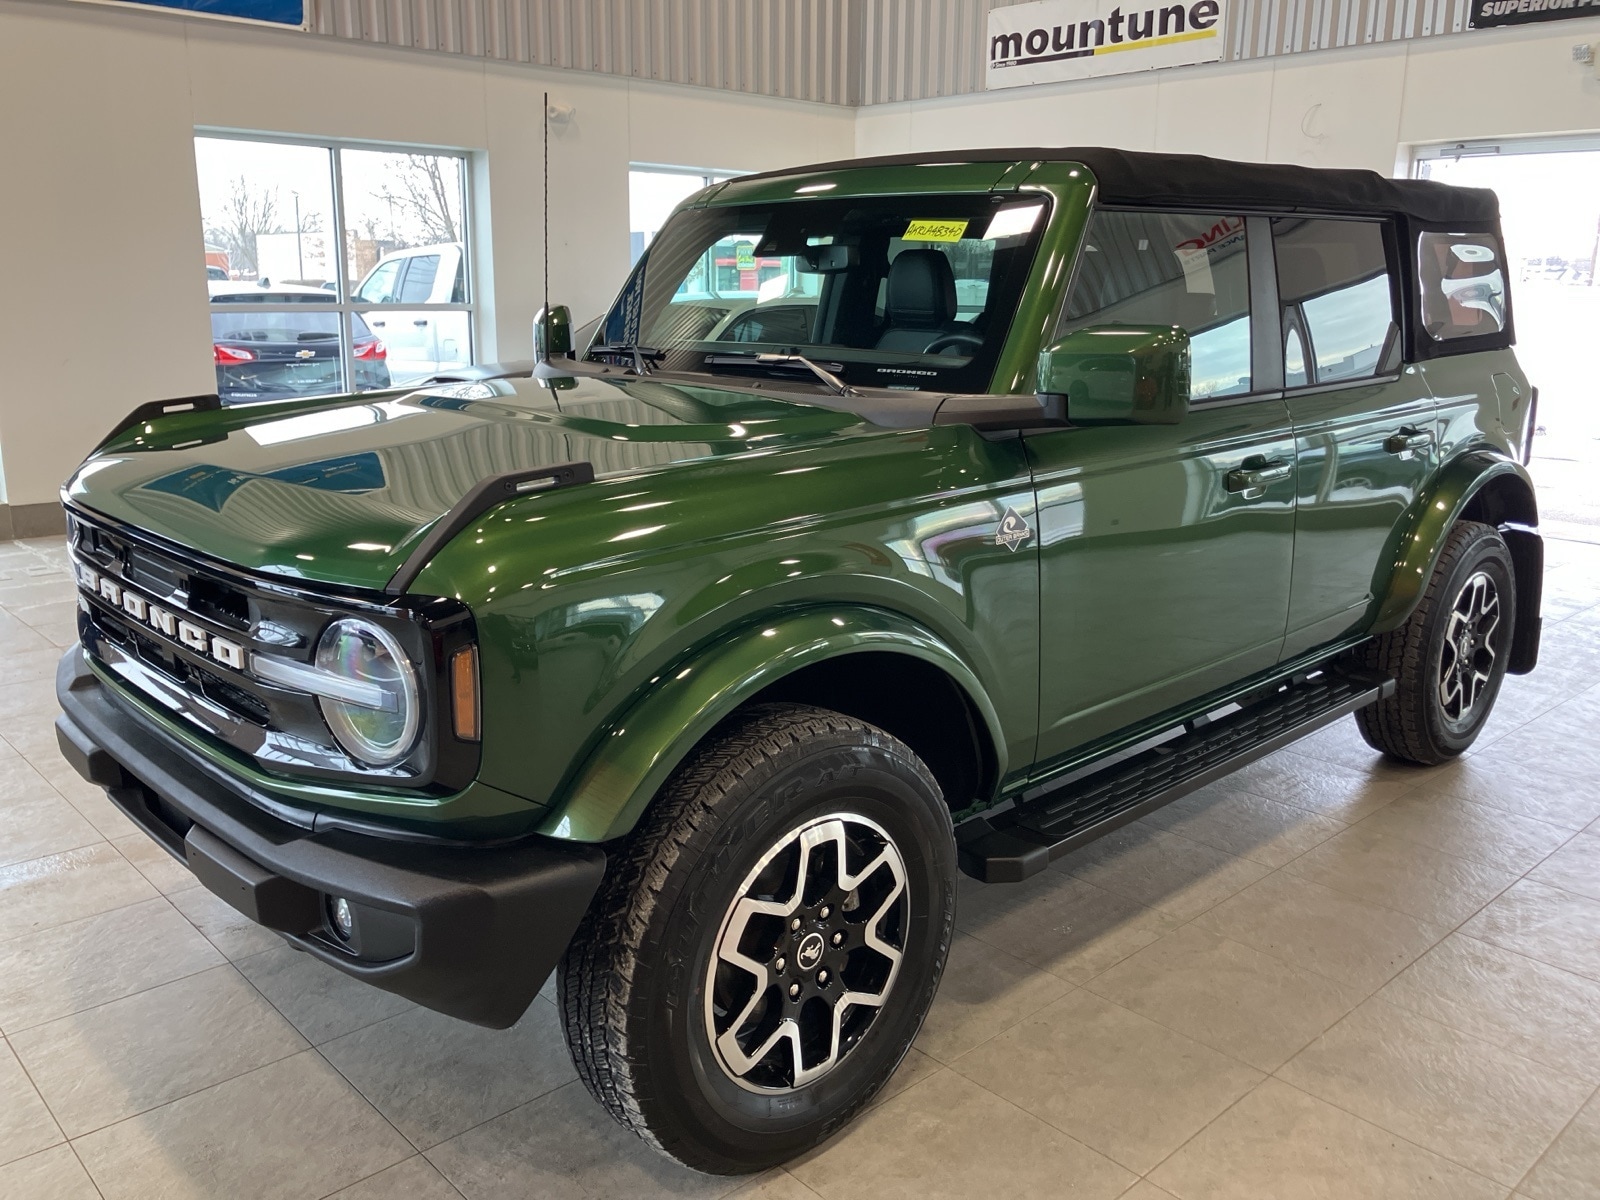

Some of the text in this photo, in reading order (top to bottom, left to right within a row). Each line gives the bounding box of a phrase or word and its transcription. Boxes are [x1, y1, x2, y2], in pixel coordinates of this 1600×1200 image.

[1481, 0, 1574, 17] SUPERIOR
[991, 0, 1219, 60] mountune
[877, 368, 938, 376] BRONCO
[79, 564, 244, 669] BRONCO
